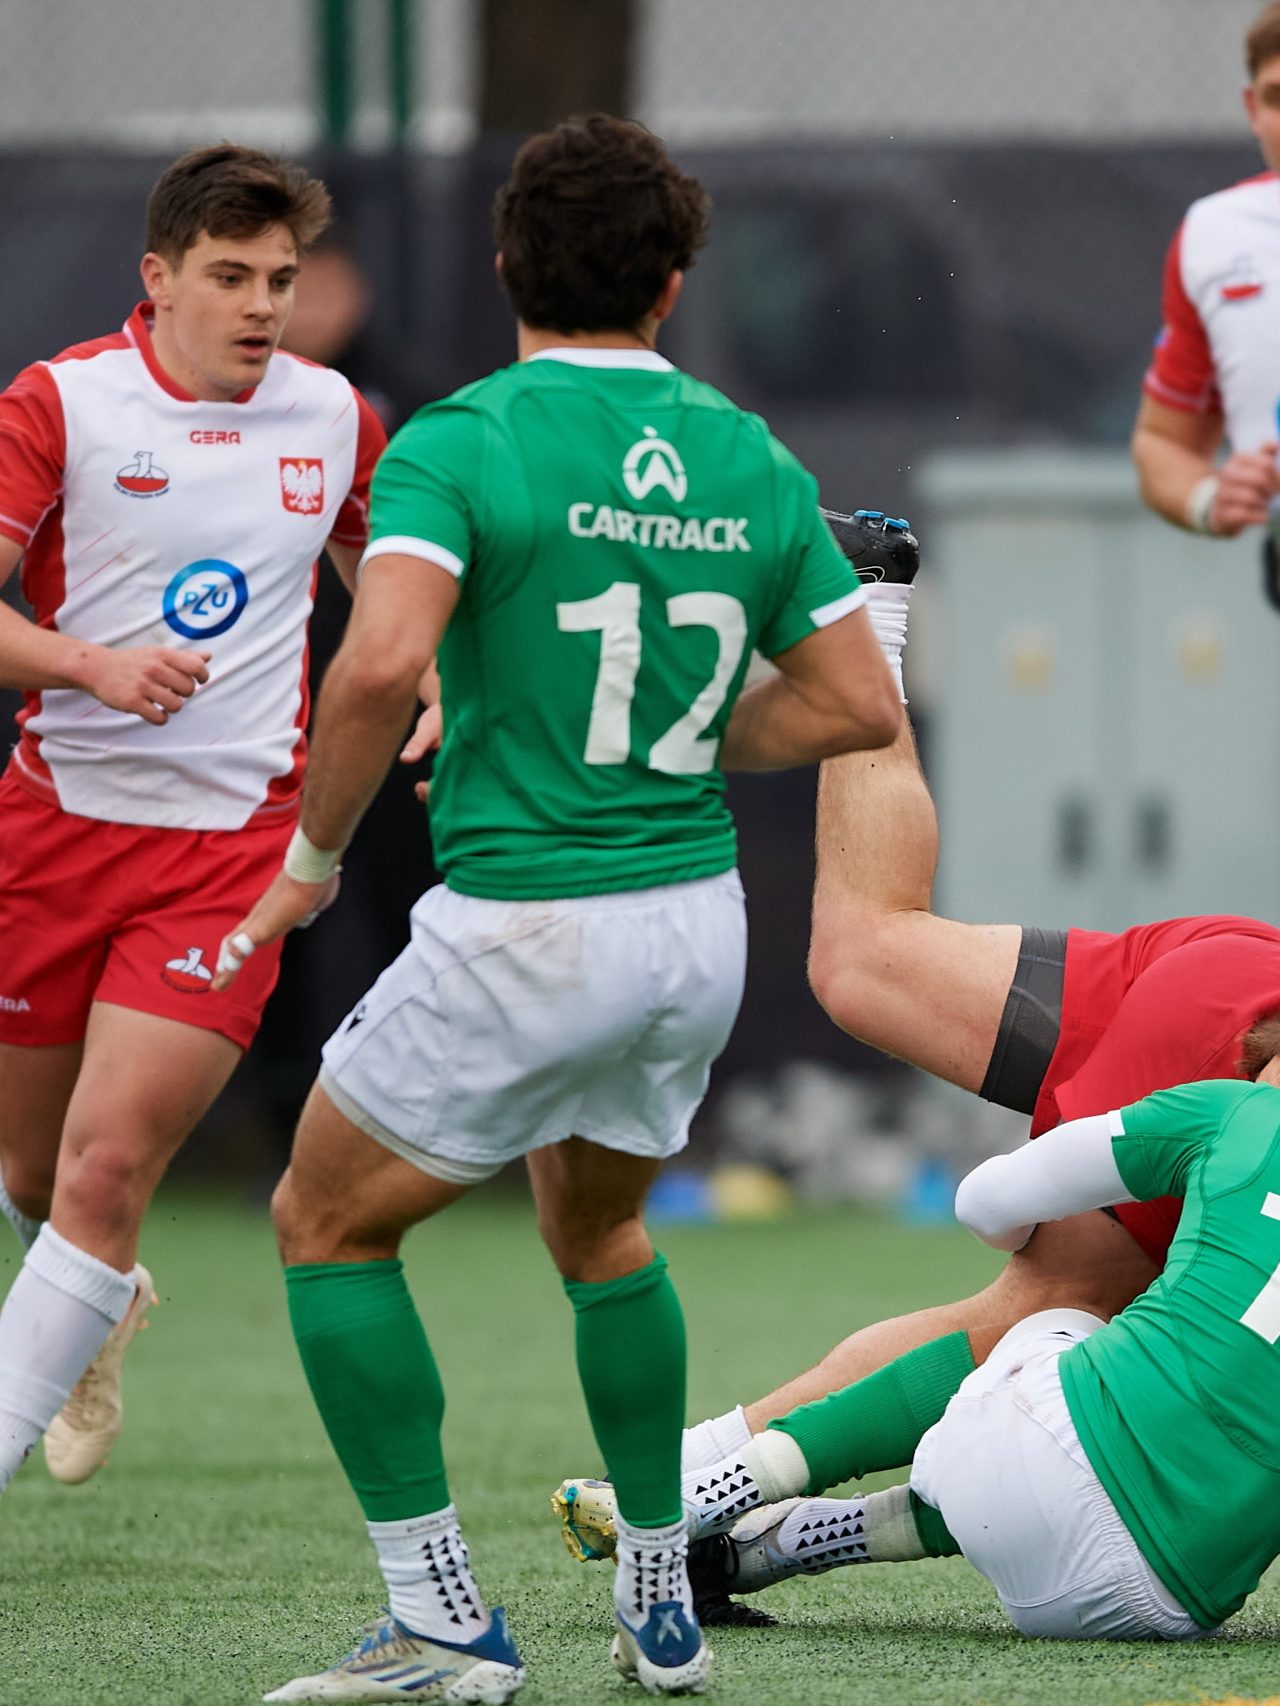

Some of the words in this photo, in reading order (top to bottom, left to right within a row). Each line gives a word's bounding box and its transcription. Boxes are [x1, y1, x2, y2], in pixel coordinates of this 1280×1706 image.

[190, 430, 240, 445] GERA
[567, 502, 751, 552] CARTRACK
[183, 584, 228, 615] PZU
[556, 581, 748, 776] 12
